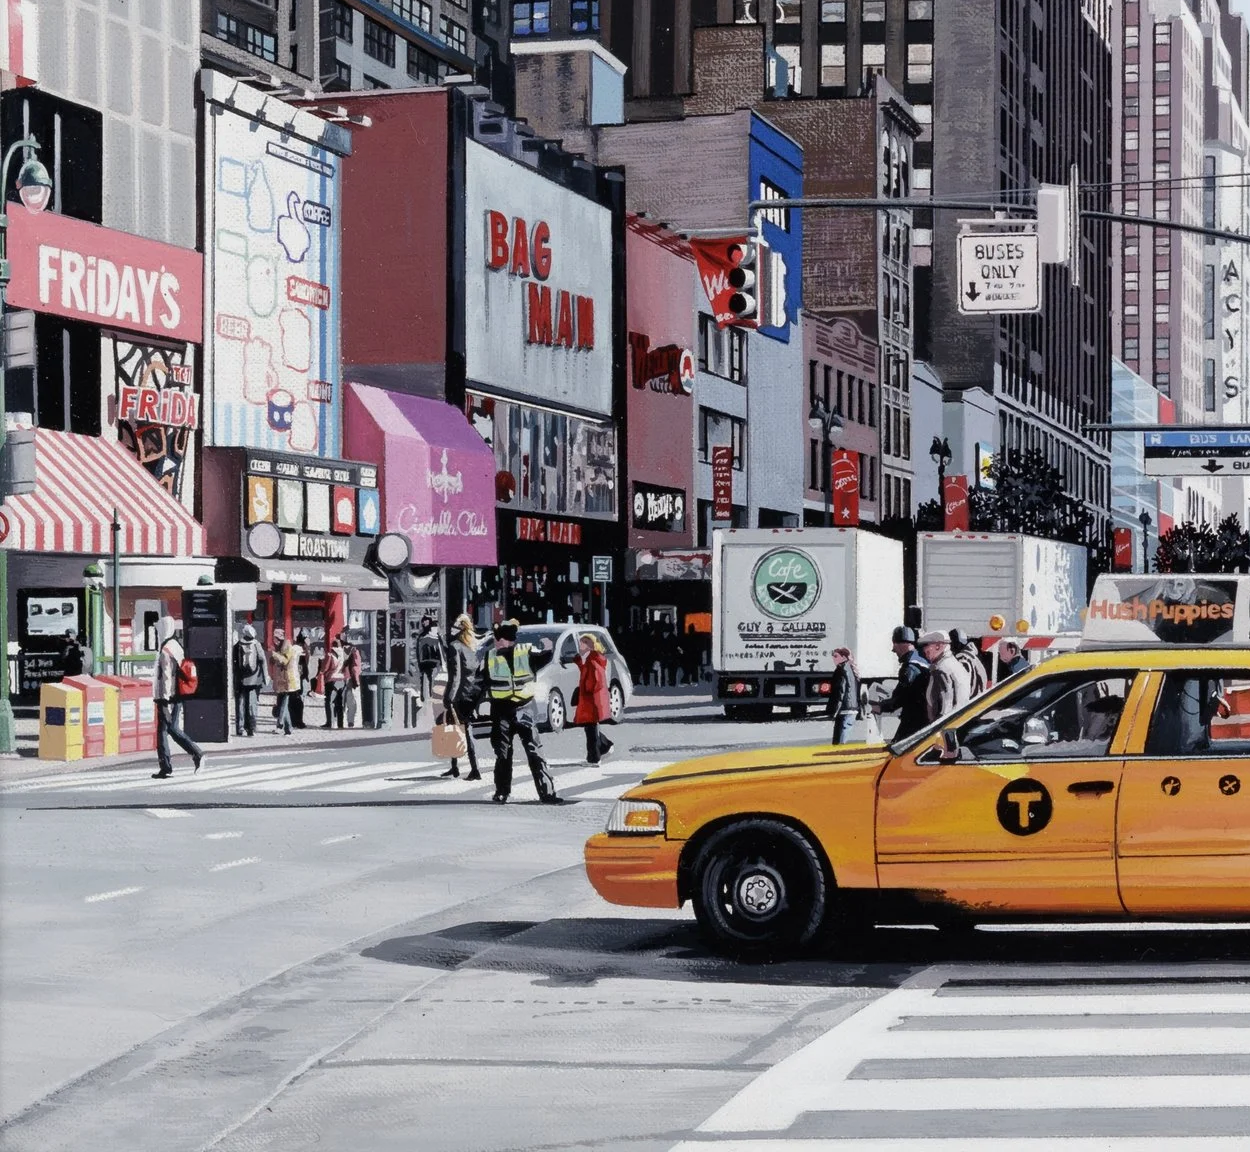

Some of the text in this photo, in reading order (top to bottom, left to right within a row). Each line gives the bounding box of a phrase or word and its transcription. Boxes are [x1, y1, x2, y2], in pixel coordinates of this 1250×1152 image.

[484, 209, 552, 281] BAG
[975, 243, 1024, 260] BUSES
[981, 264, 1019, 279] ONLY
[521, 280, 594, 352] MAN
[1190, 434, 1217, 445] BUS
[1090, 597, 1234, 625] Hush Puppies
[1007, 791, 1042, 828] T
